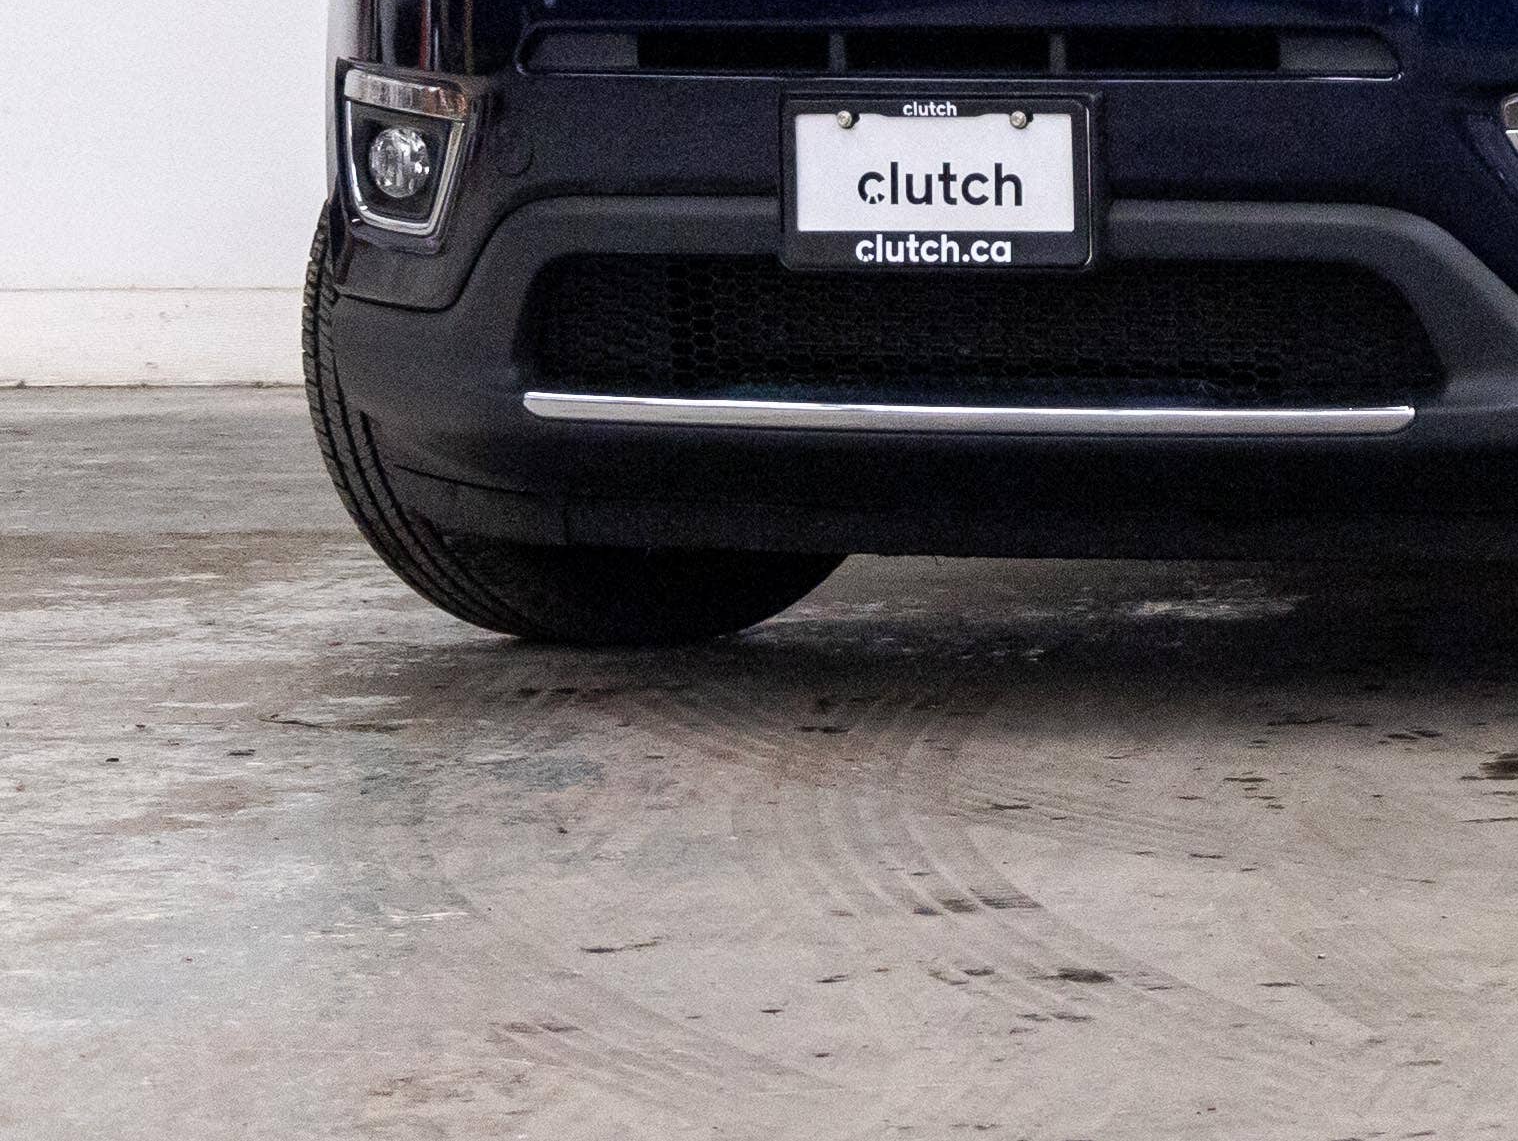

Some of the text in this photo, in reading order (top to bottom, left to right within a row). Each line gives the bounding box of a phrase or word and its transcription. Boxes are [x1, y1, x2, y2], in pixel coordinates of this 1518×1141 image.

[902, 100, 958, 116] clutch
[857, 161, 1023, 206] clutch
[855, 233, 1012, 263] clutch.ca
